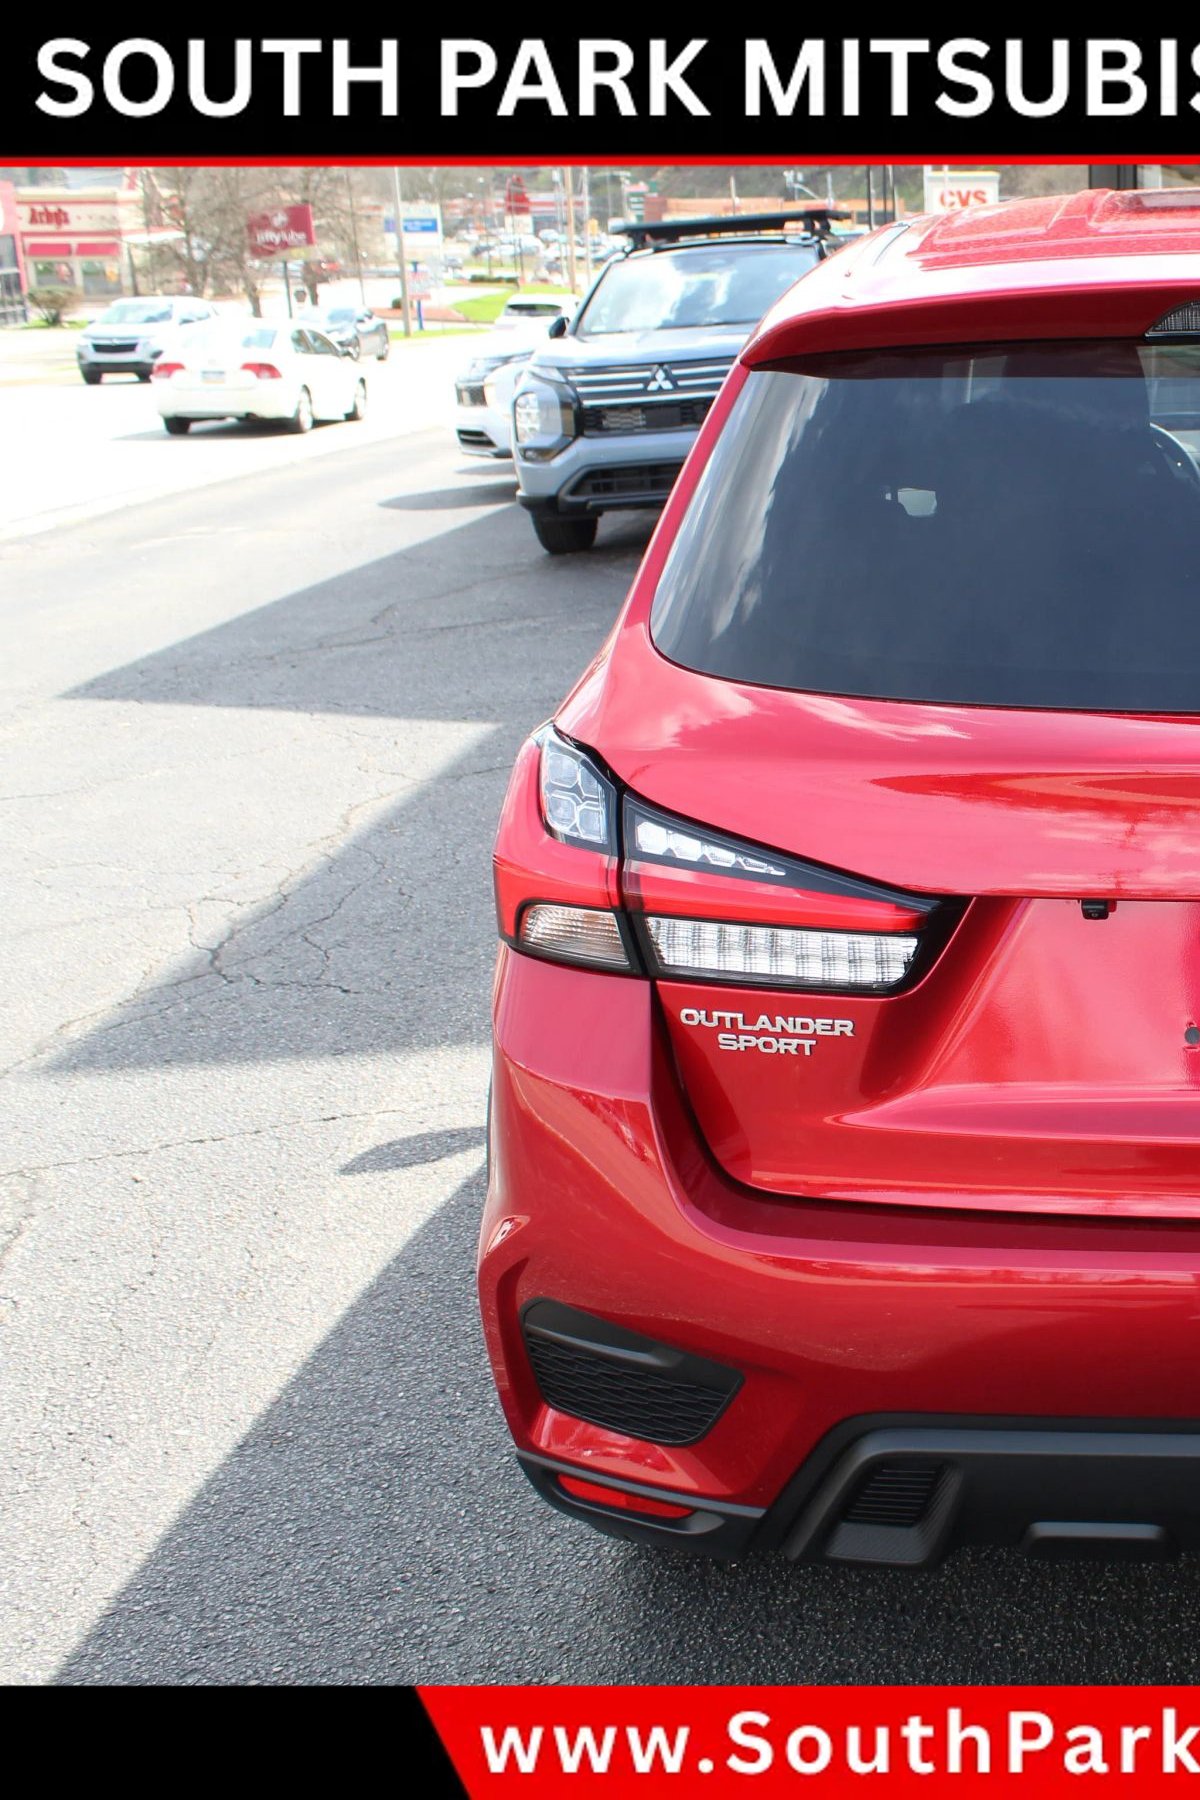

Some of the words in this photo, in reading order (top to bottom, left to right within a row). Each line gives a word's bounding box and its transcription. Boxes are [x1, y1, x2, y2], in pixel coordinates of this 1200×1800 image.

[939, 189, 987, 207] CVS
[680, 1008, 855, 1037] OUTLANDER
[717, 1033, 817, 1056] SPORT
